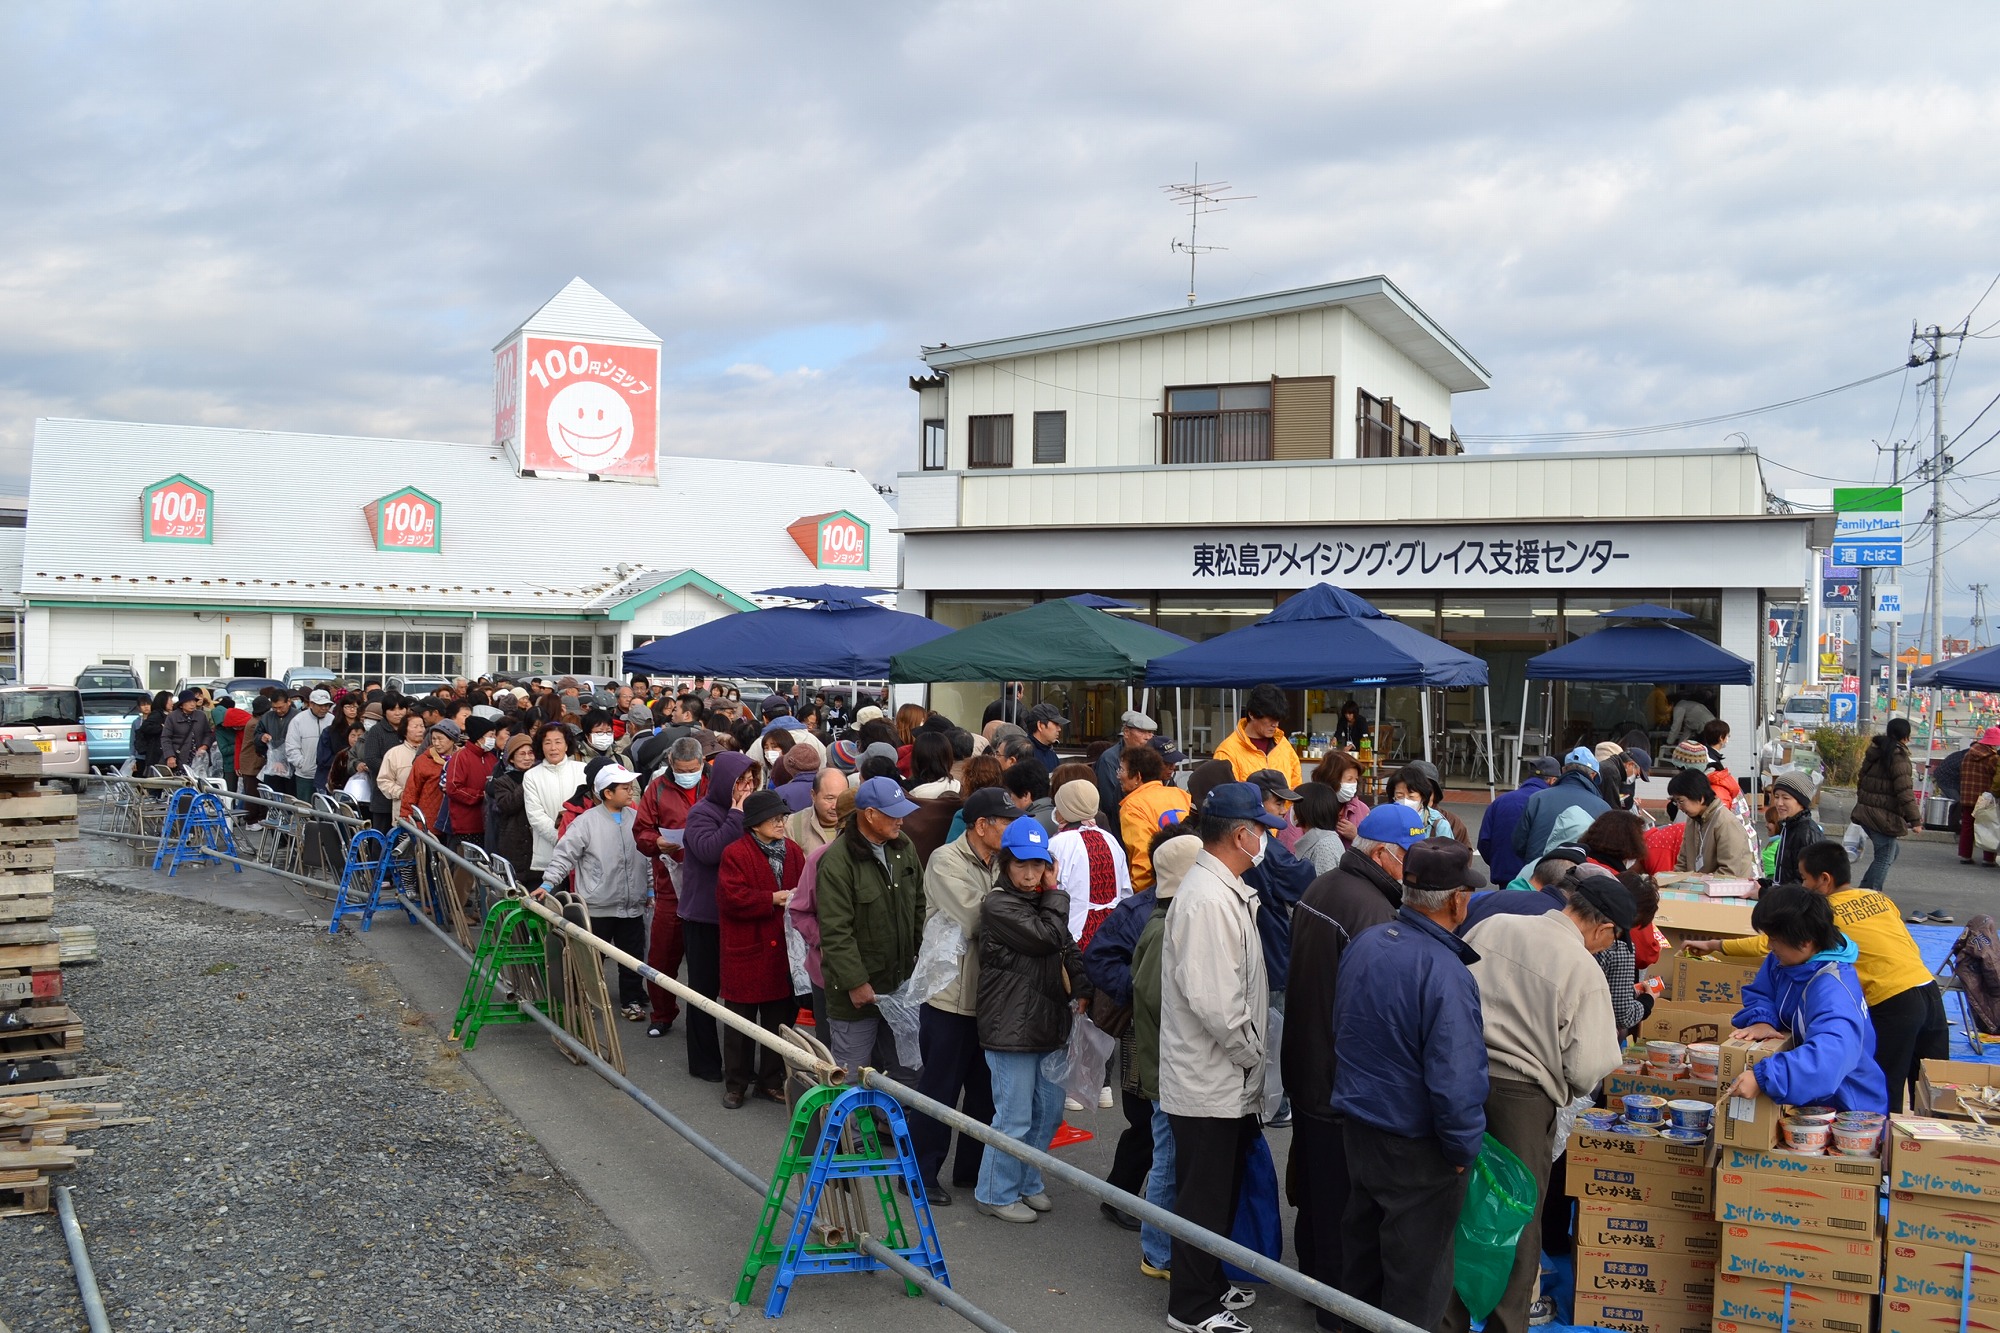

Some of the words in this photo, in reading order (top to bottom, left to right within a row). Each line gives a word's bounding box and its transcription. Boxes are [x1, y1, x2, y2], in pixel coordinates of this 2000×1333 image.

[529, 345, 652, 395] 100円ショップ
[152, 491, 205, 522] 100円
[385, 502, 434, 532] 100円
[1835, 518, 1901, 532] FamilyMart
[165, 522, 206, 536] ショップ
[397, 532, 434, 545] ショップ
[822, 525, 863, 552] 100円
[833, 551, 863, 563] ショップ
[1840, 548, 1857, 563] 酒
[1863, 549, 1897, 562] たばこ
[1878, 603, 1901, 612] ATM
[1881, 595, 1898, 604] 銀行
[1836, 699, 1853, 719] P
[1841, 913, 1855, 925] IT
[1853, 909, 1866, 921] IS
[1579, 1136, 1637, 1154] じゃが塩
[1730, 1151, 1808, 1172] 上州らーめん
[1811, 1165, 1827, 1173] みそ
[1596, 1170, 1633, 1183] 野菜盛り
[1898, 1170, 1982, 1195] 上州らーめん
[1584, 1183, 1643, 1201] じゃが塩
[1723, 1203, 1800, 1226] 上州らーめん
[1804, 1219, 1819, 1227] みそ
[1610, 1219, 1647, 1231] 野菜盛り
[1894, 1220, 1976, 1246] 上州らーめん
[1598, 1232, 1657, 1249] じゃが塩
[1607, 1263, 1647, 1275] 野菜盛り
[1728, 1254, 1805, 1279] 上州らーめん
[1809, 1272, 1824, 1280] みそ
[1594, 1275, 1657, 1293] じゃが塩
[1605, 1308, 1642, 1320] 野菜盛り
[1799, 1320, 1814, 1328] みそ
